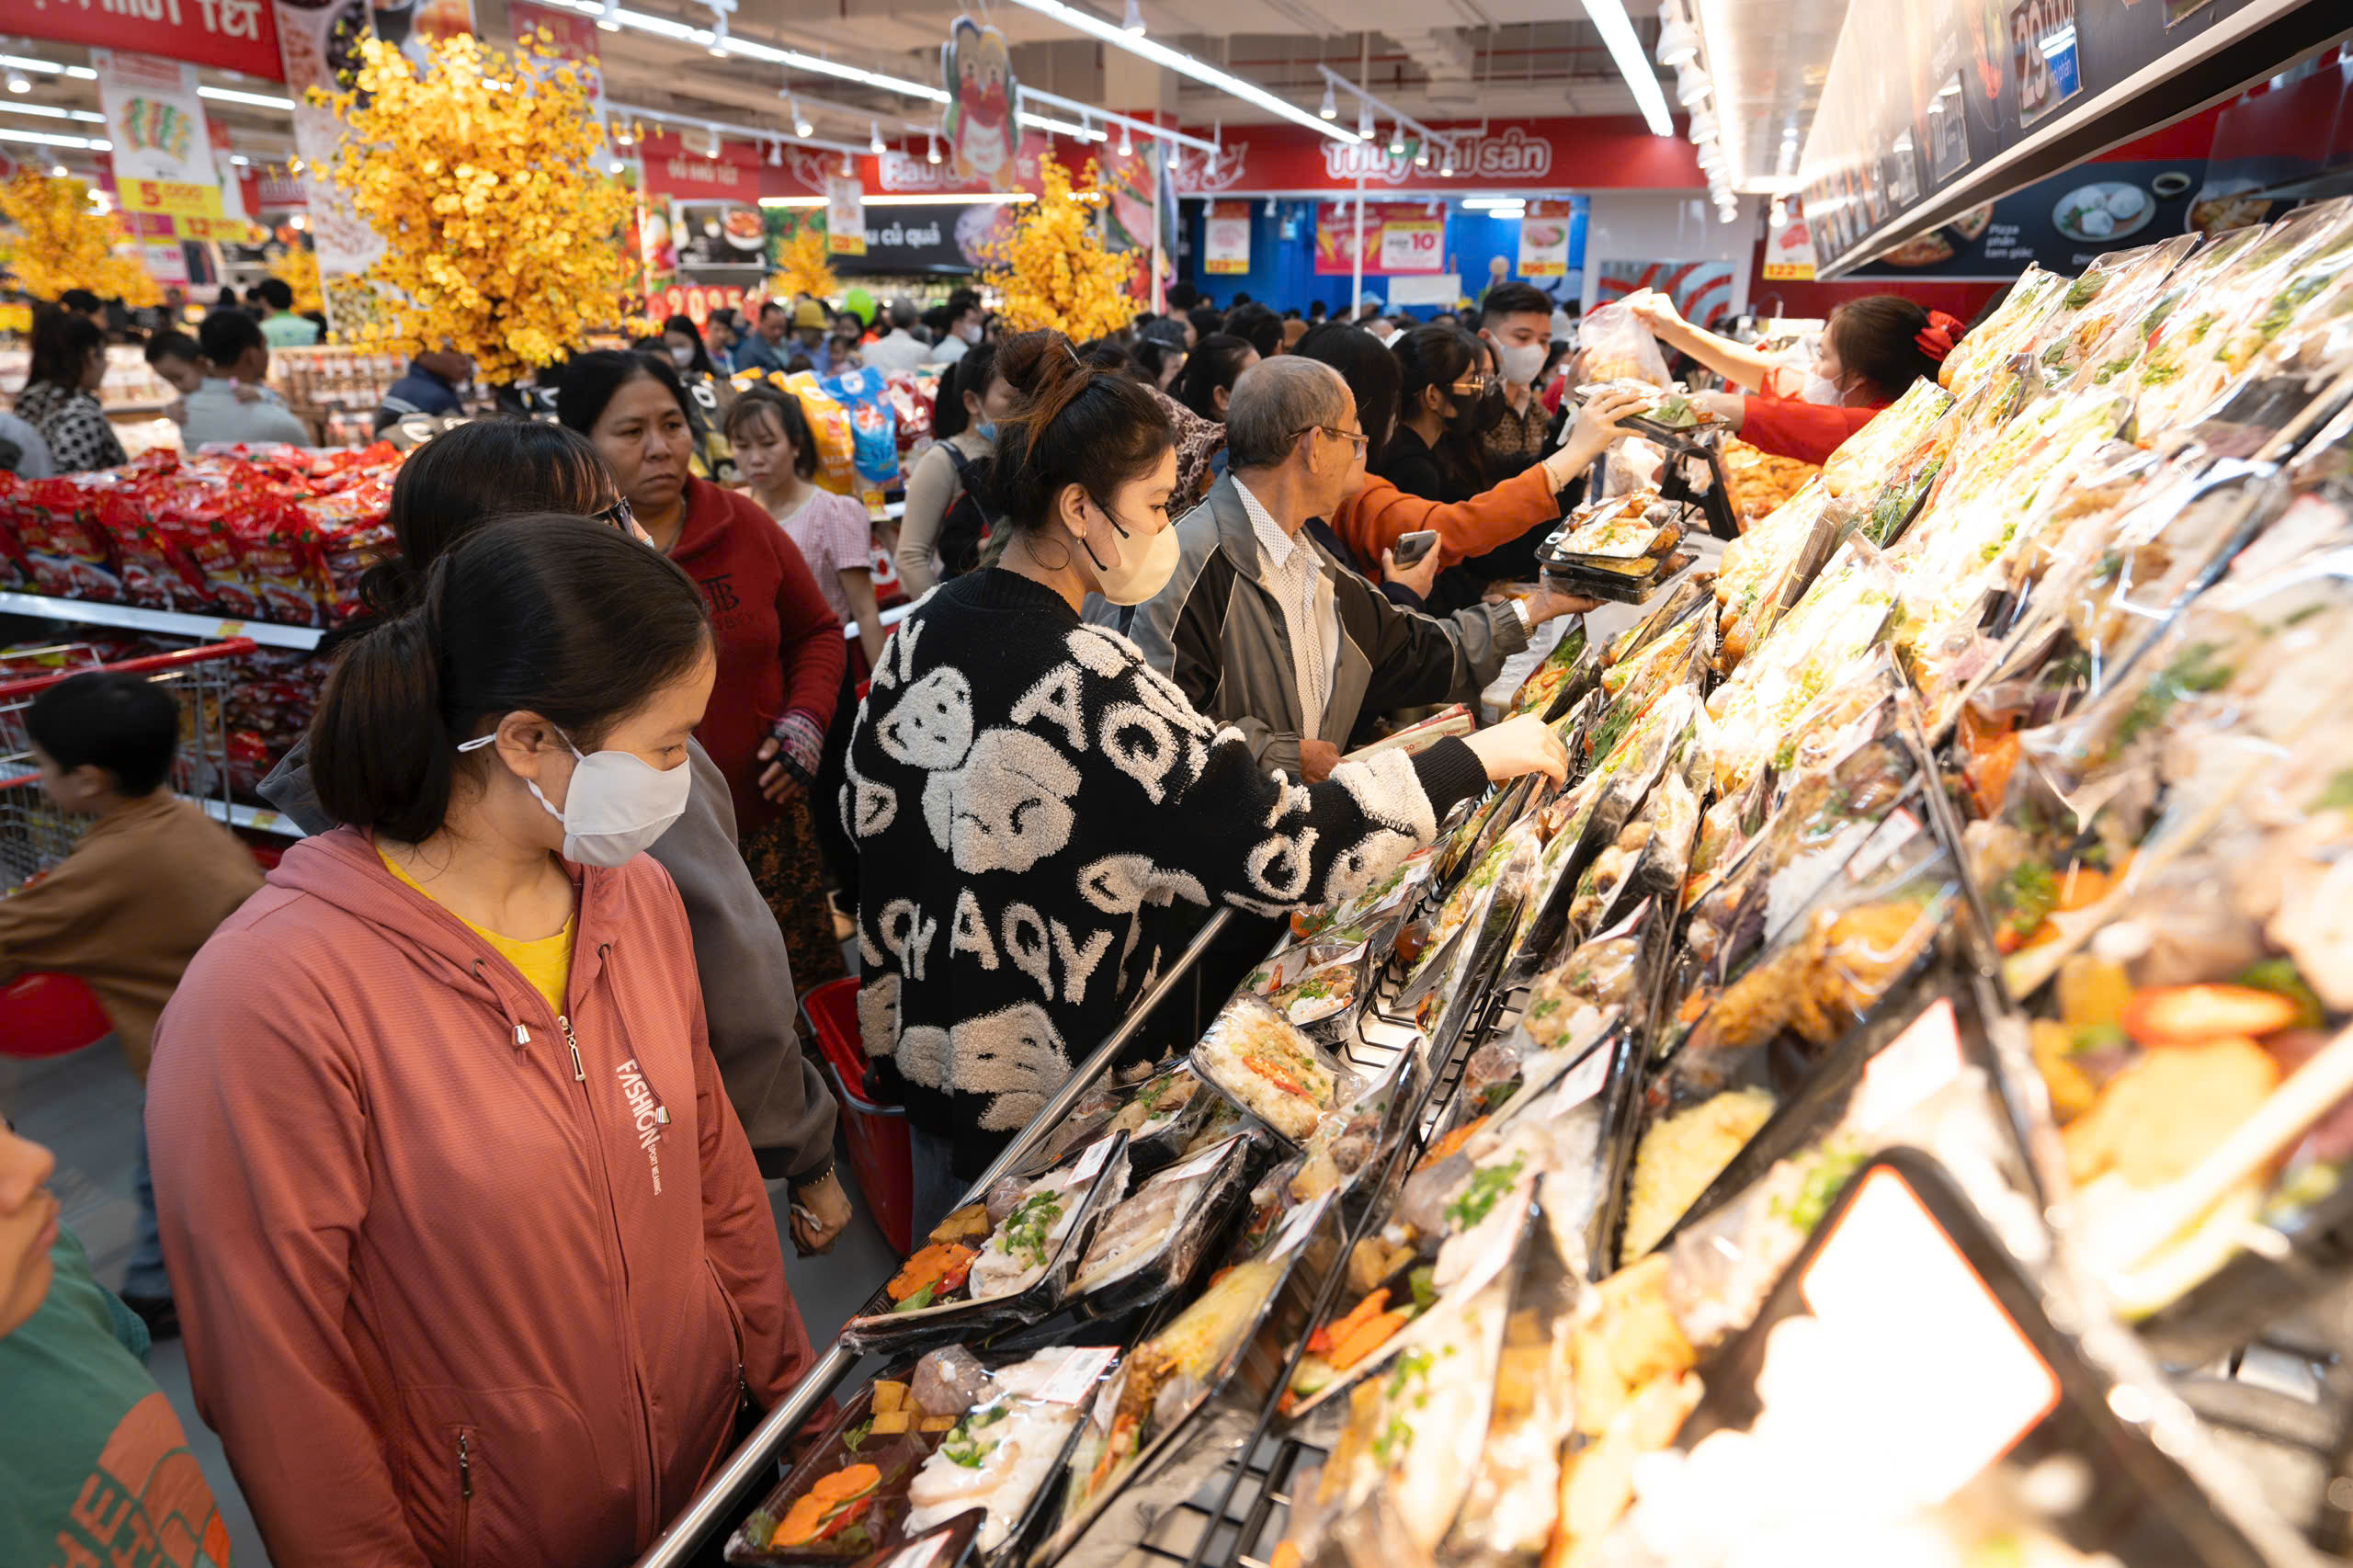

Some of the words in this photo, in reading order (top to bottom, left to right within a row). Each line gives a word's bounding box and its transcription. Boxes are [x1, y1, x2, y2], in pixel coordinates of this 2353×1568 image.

[1412, 233, 1435, 251] 10
[616, 1059, 662, 1149] FASHION
[647, 1143, 658, 1166] SPORT
